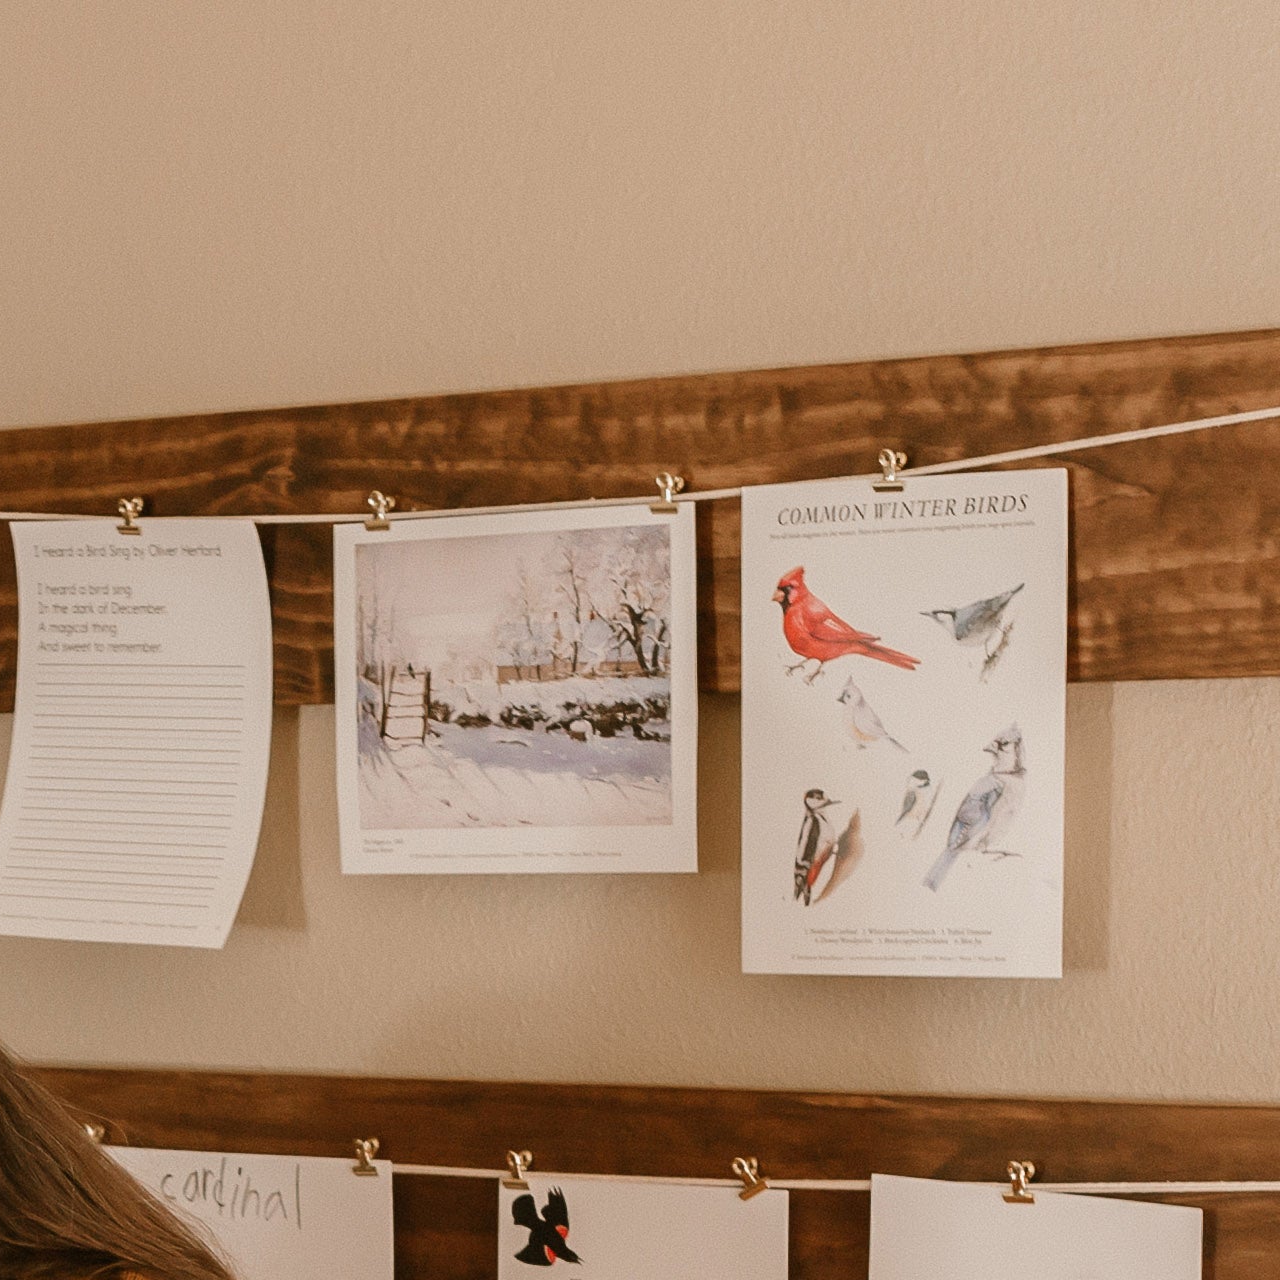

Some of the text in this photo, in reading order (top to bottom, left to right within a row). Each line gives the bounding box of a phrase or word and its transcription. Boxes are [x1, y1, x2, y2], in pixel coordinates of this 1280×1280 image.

[777, 494, 1029, 526] COMMON WINTER BIRDS
[160, 1156, 302, 1230] cardinal
